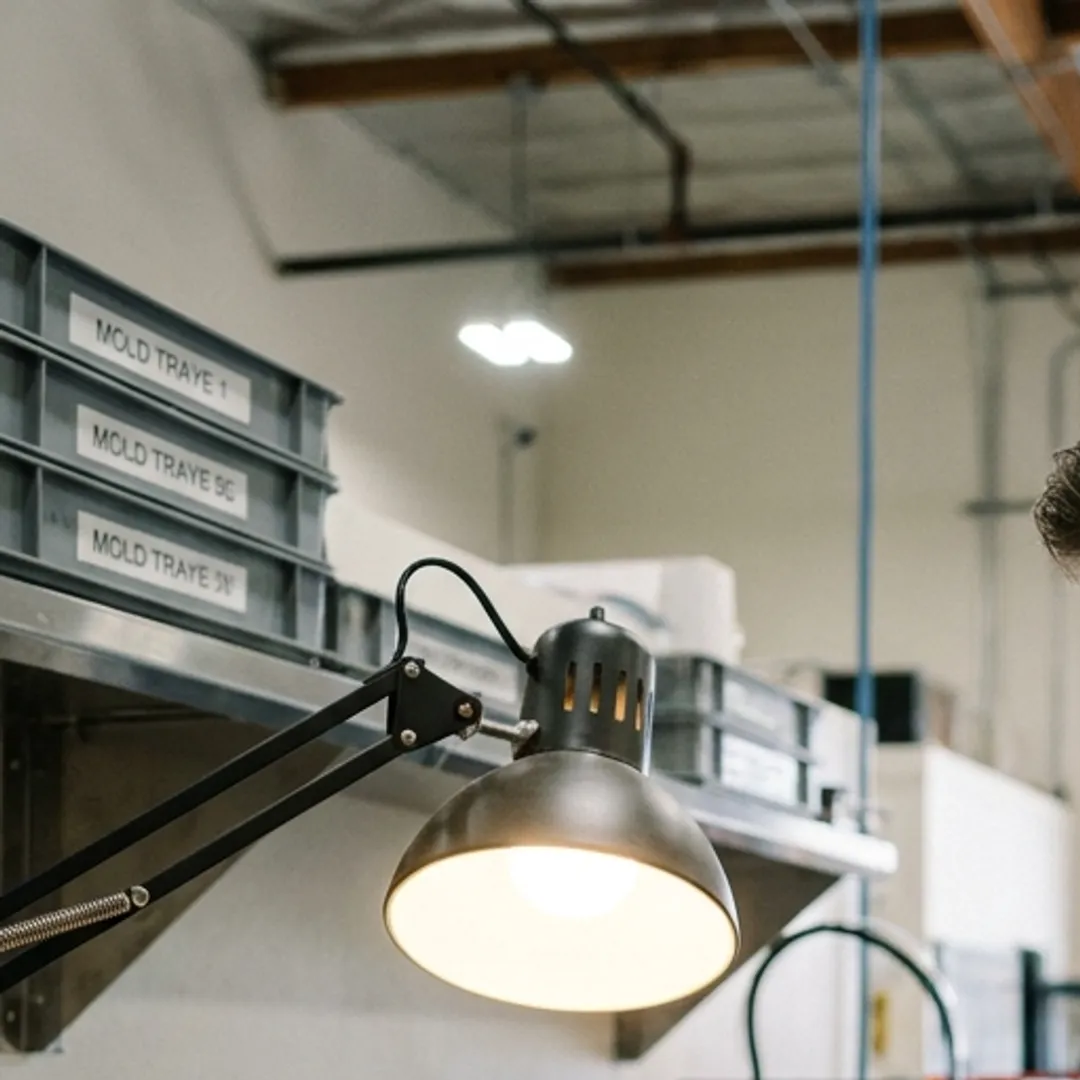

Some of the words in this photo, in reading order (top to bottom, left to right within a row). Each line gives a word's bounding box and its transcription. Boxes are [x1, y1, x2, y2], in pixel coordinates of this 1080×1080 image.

[96, 317, 150, 364] MOLD
[155, 347, 214, 395] TRAYE
[92, 424, 147, 466] MOLD
[151, 448, 210, 492] TRAYE
[92, 528, 147, 567] MOLD
[151, 549, 210, 588] TRAYE
